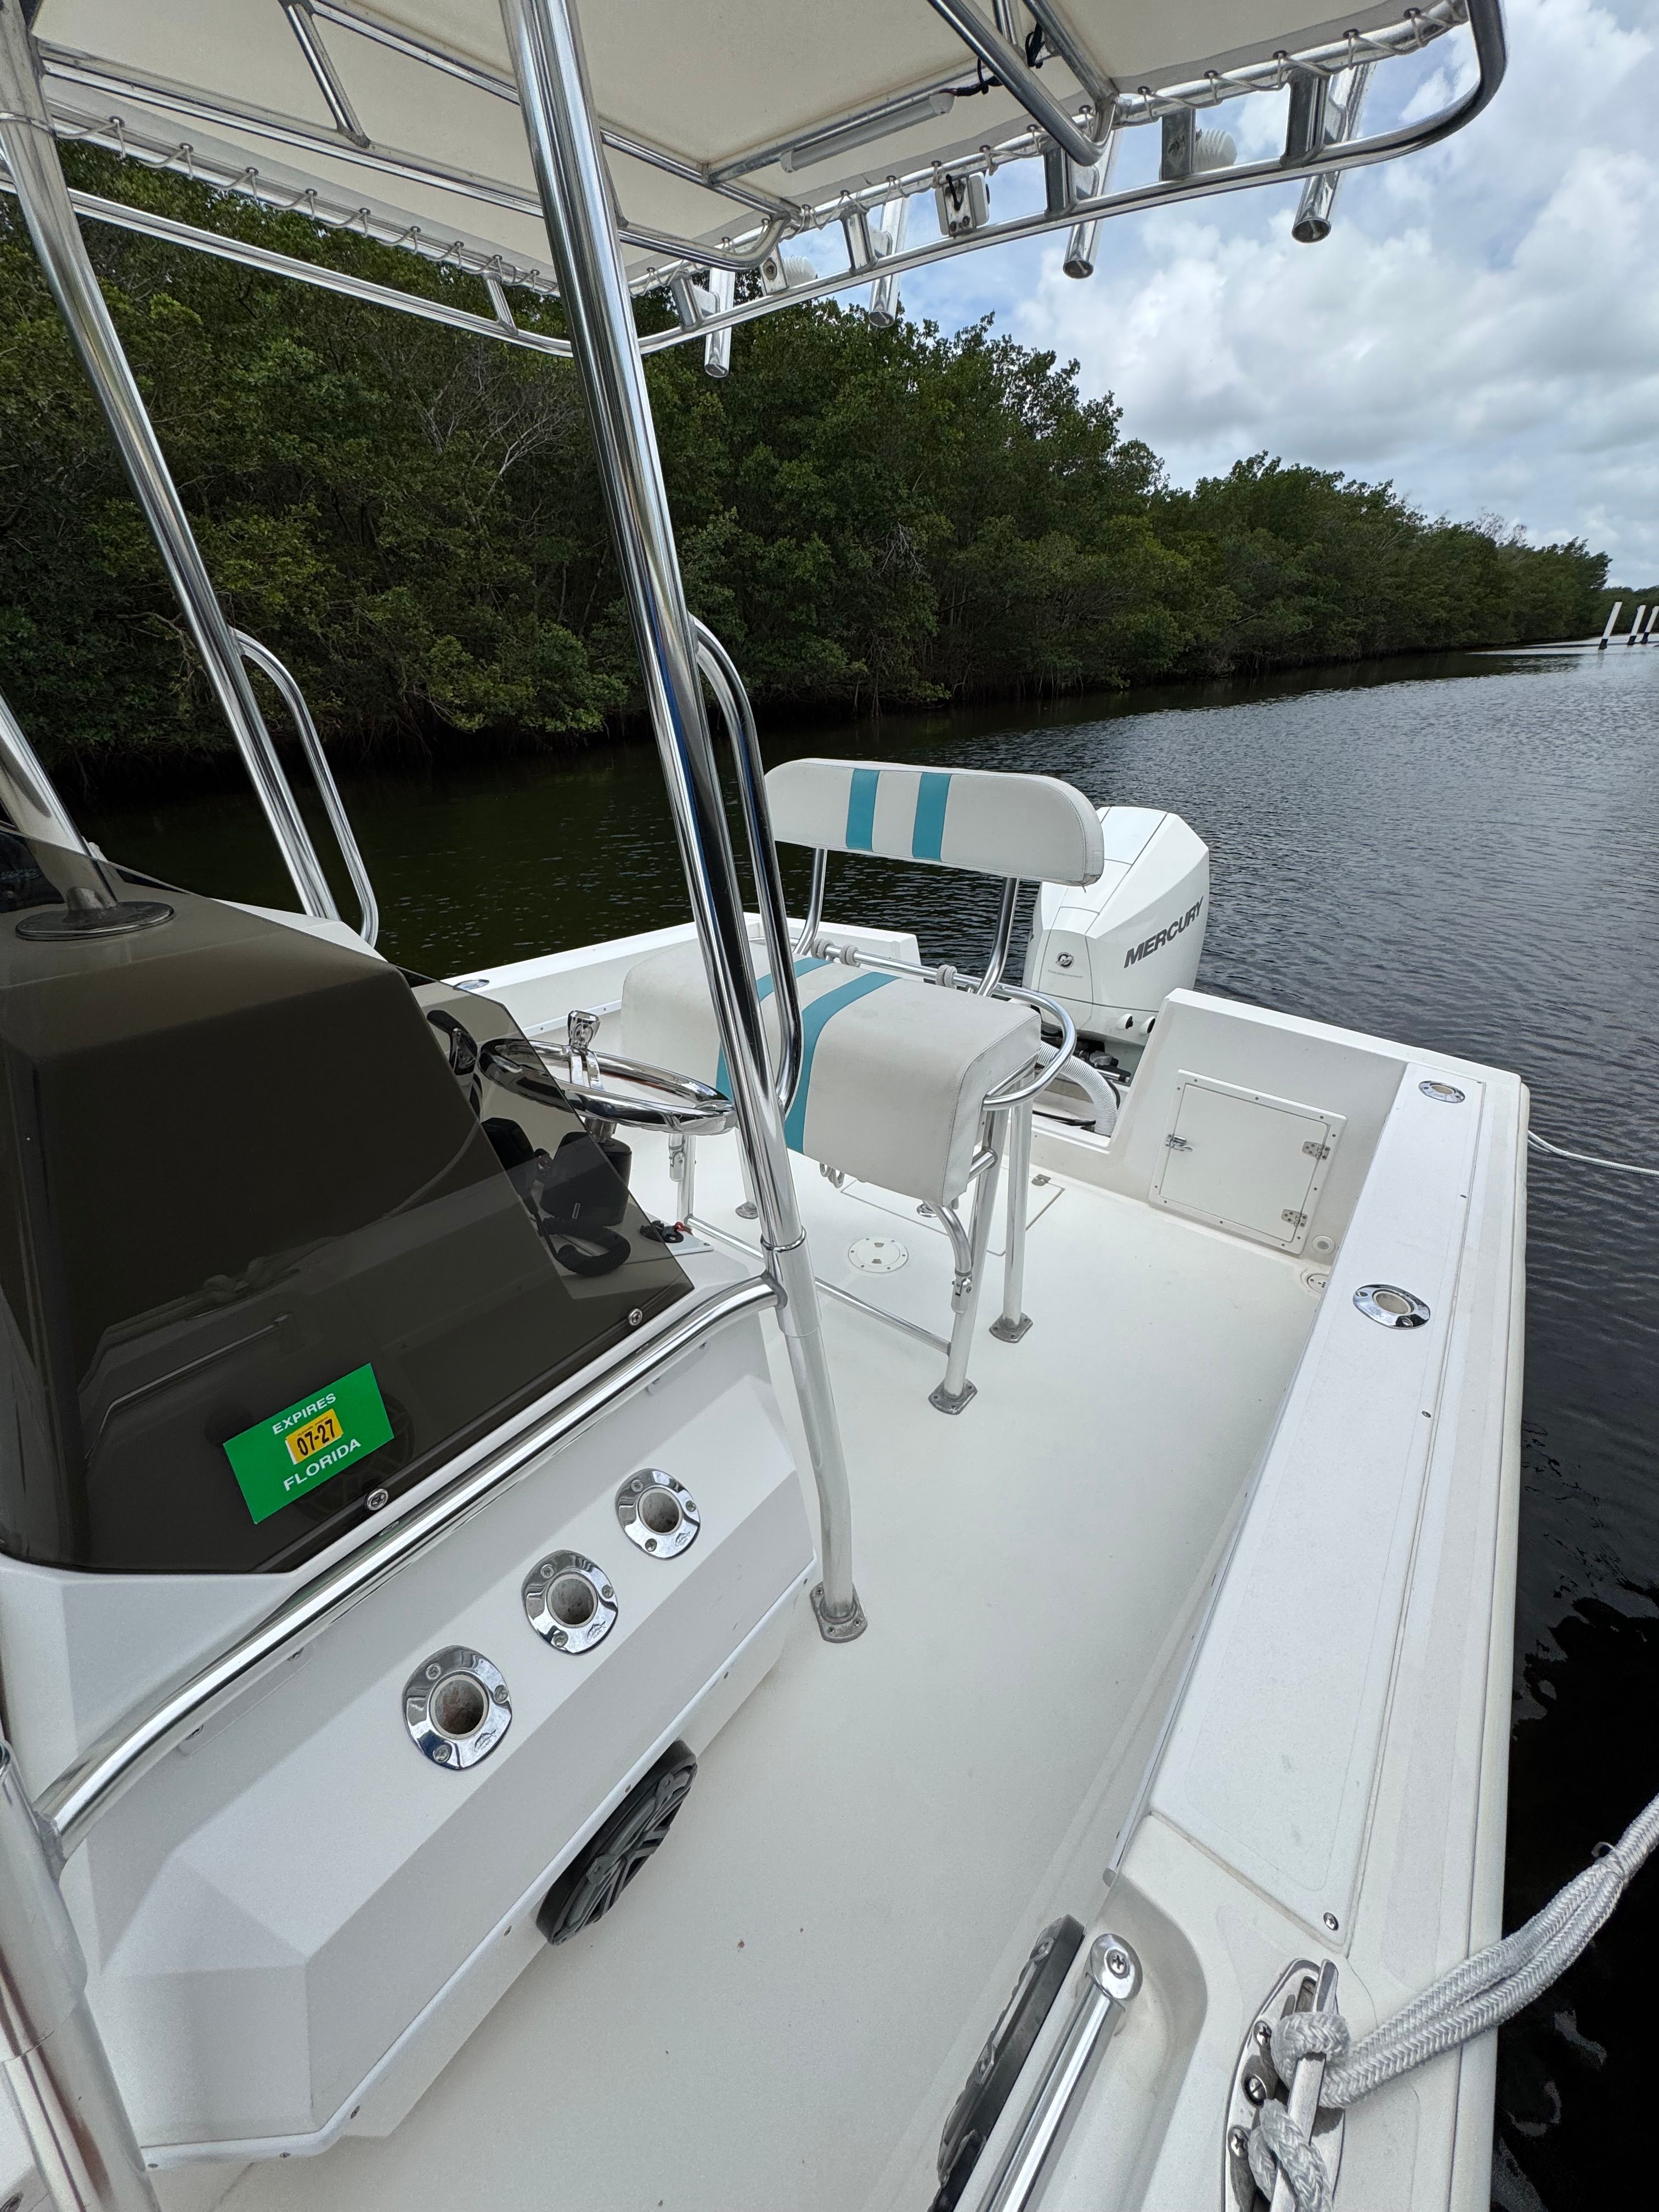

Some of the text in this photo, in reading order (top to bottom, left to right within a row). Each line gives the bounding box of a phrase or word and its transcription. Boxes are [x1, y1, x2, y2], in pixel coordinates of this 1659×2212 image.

[1124, 895, 1204, 968] MERCURY
[273, 1393, 336, 1435] EXPIRES
[297, 1419, 335, 1456] 07-27
[283, 1438, 362, 1491] FLORIDA
